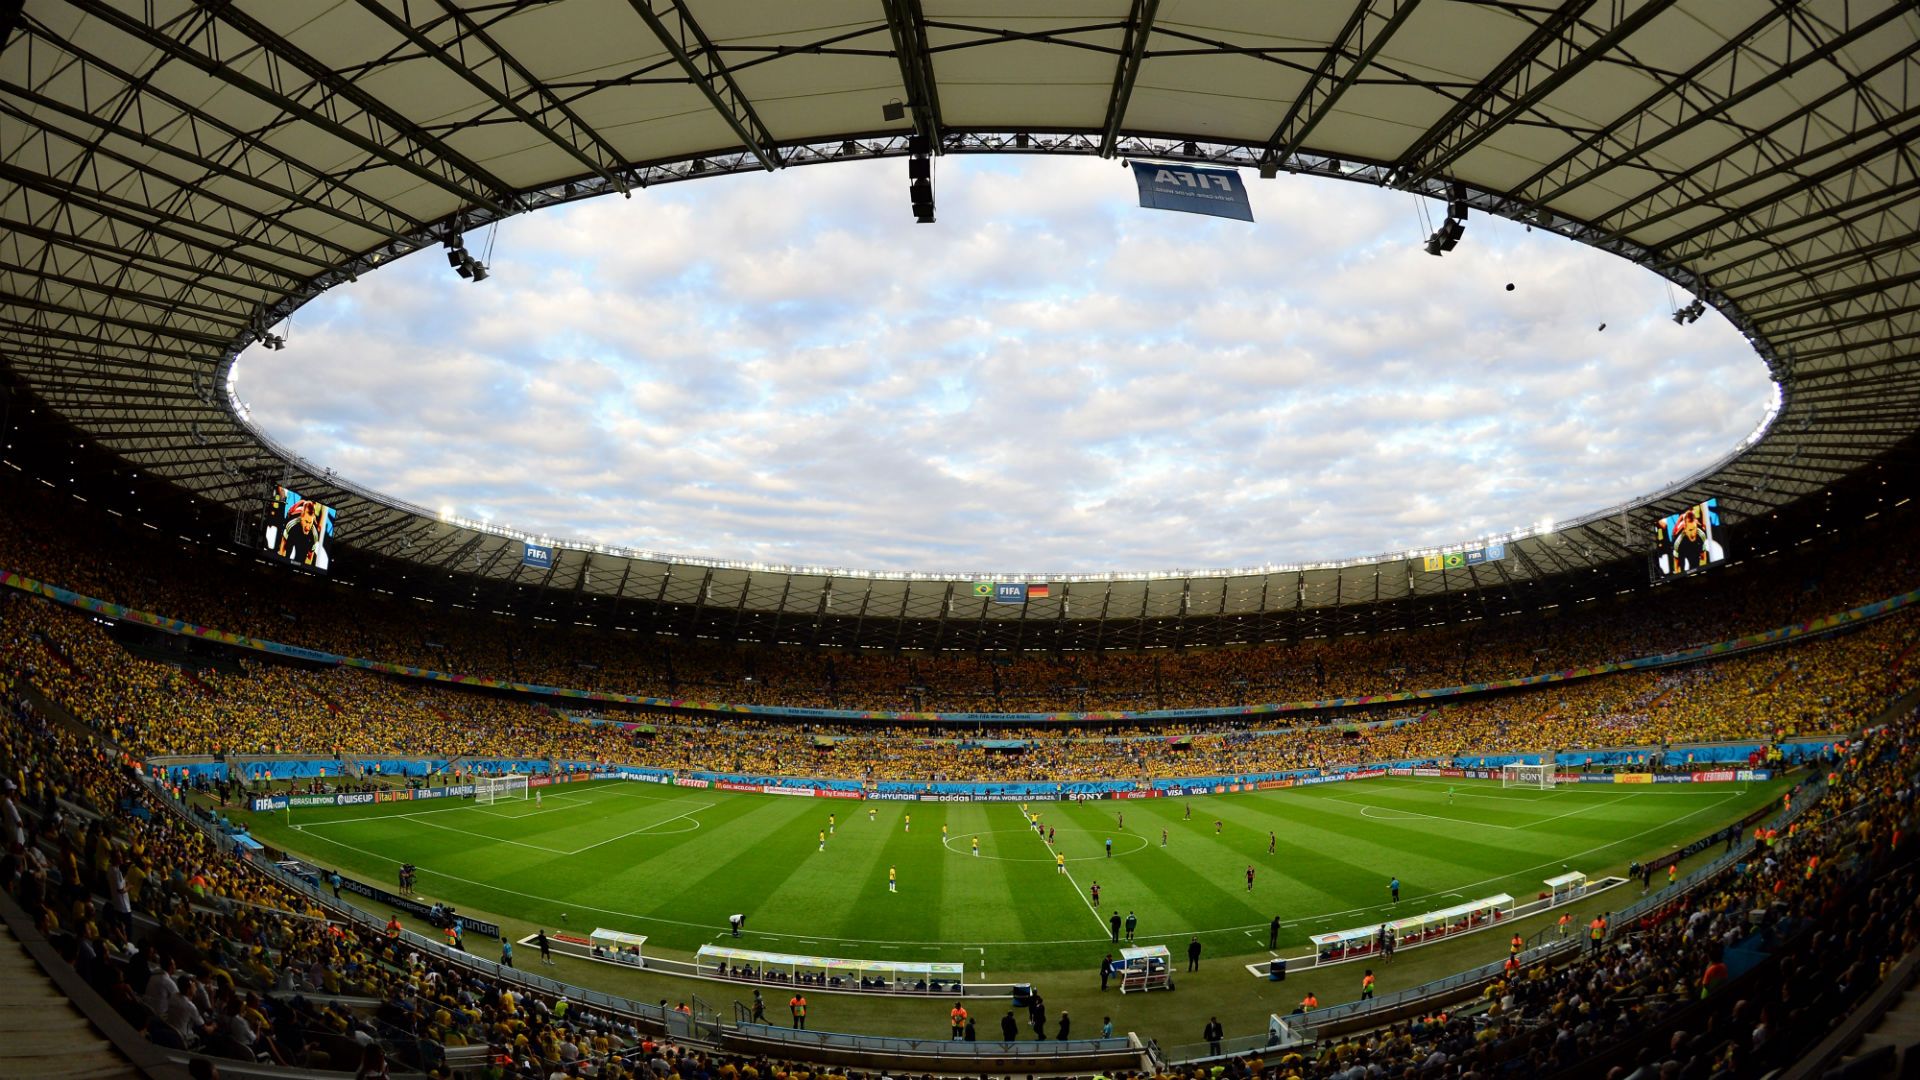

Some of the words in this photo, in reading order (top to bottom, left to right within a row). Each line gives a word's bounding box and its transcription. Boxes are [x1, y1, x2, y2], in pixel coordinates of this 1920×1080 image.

[527, 548, 547, 560] FIFA
[1000, 587, 1020, 595] FIFA
[628, 773, 658, 782] MARFRIG
[1304, 777, 1324, 785] YINGLI
[1520, 773, 1542, 781] SONY
[940, 794, 970, 802] adidas
[344, 881, 372, 897] adidas
[464, 920, 499, 936] UNDAI
